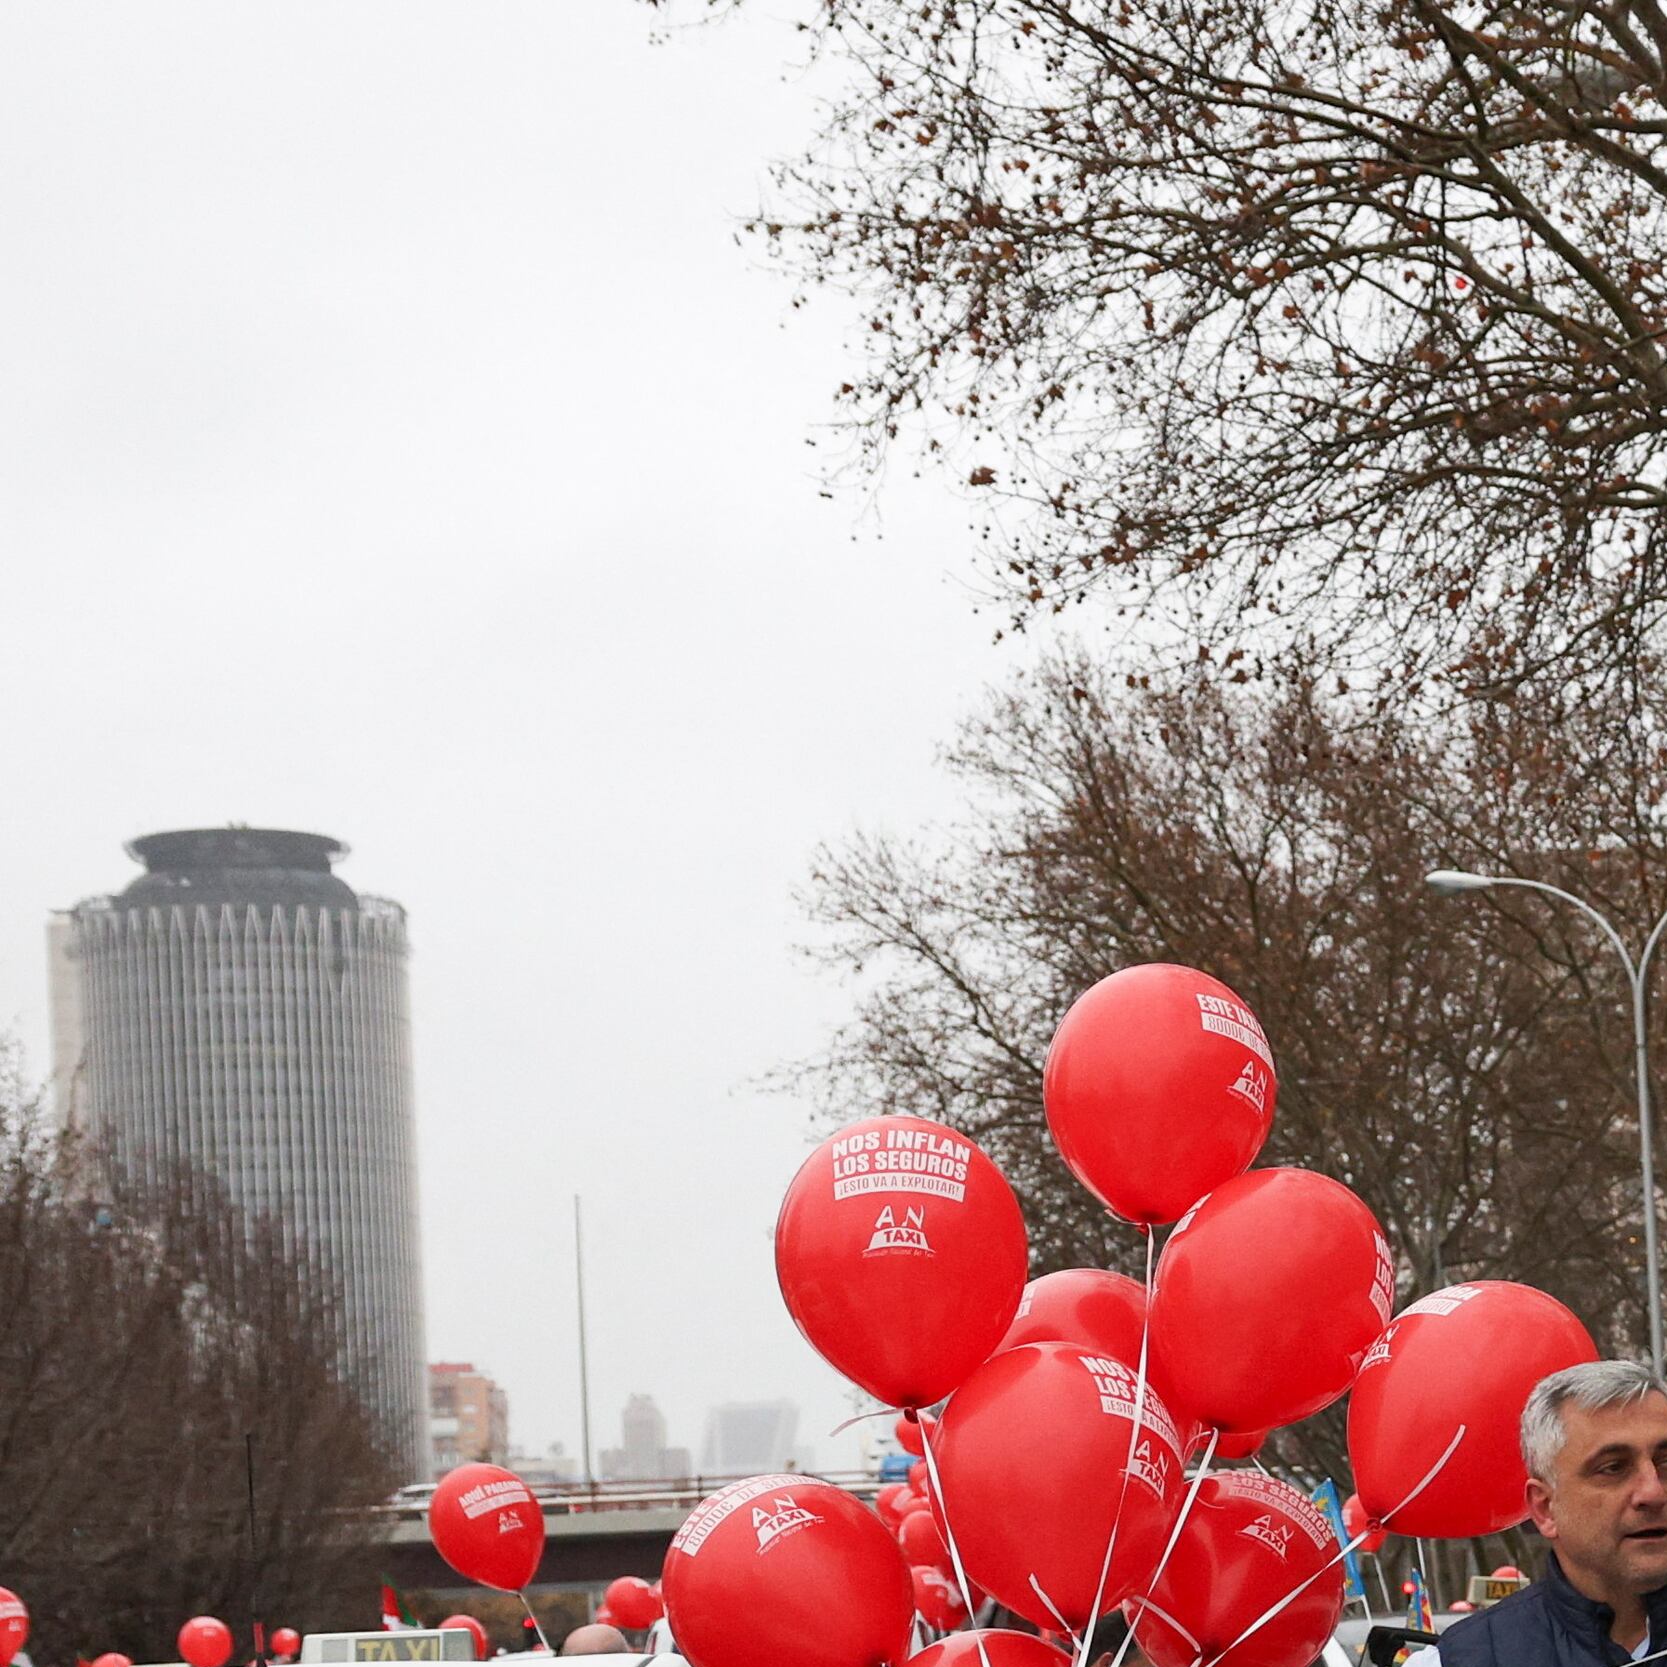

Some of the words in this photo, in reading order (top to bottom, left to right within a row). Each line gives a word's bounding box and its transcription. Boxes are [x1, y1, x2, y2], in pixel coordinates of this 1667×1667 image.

[832, 1131, 881, 1160] NOS
[887, 1129, 971, 1164] INFLAN
[833, 1153, 870, 1179] LOS
[874, 1150, 968, 1181] SEGUROS
[872, 1175, 888, 1188] VA
[890, 1175, 898, 1187] A
[883, 1230, 922, 1245] TAXI
[1078, 1356, 1131, 1381] NOS
[1094, 1375, 1131, 1400] LOS
[765, 1509, 807, 1532] TAXI
[1269, 1482, 1333, 1542] SEGUROS
[1257, 1527, 1284, 1550] TAXI
[357, 1637, 440, 1662] TAXI
